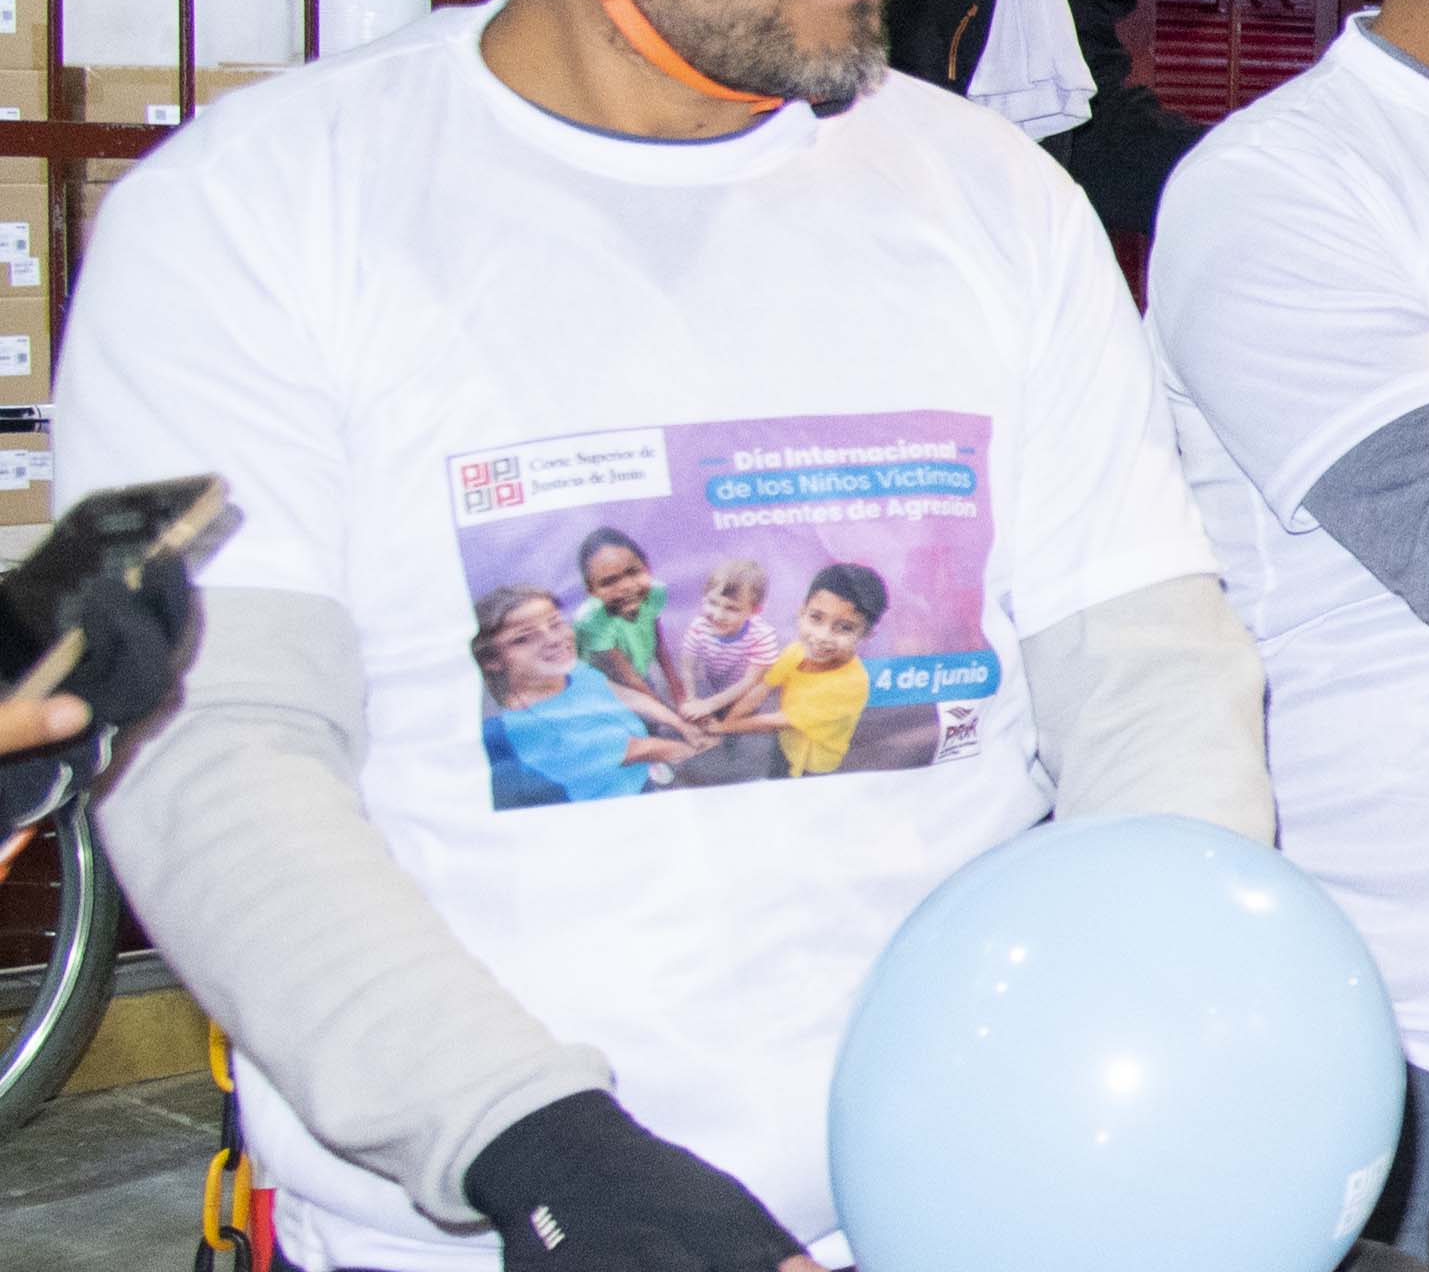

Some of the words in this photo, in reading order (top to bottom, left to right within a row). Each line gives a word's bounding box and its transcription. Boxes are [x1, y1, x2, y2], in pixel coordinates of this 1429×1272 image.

[577, 449, 635, 465] Superior
[784, 439, 957, 467] Internacional
[716, 480, 751, 500] de
[756, 476, 794, 497] los
[712, 504, 843, 529] Inocentes
[847, 501, 881, 520] de
[876, 669, 892, 690] 4
[896, 665, 929, 689] de
[931, 661, 988, 694] junio
